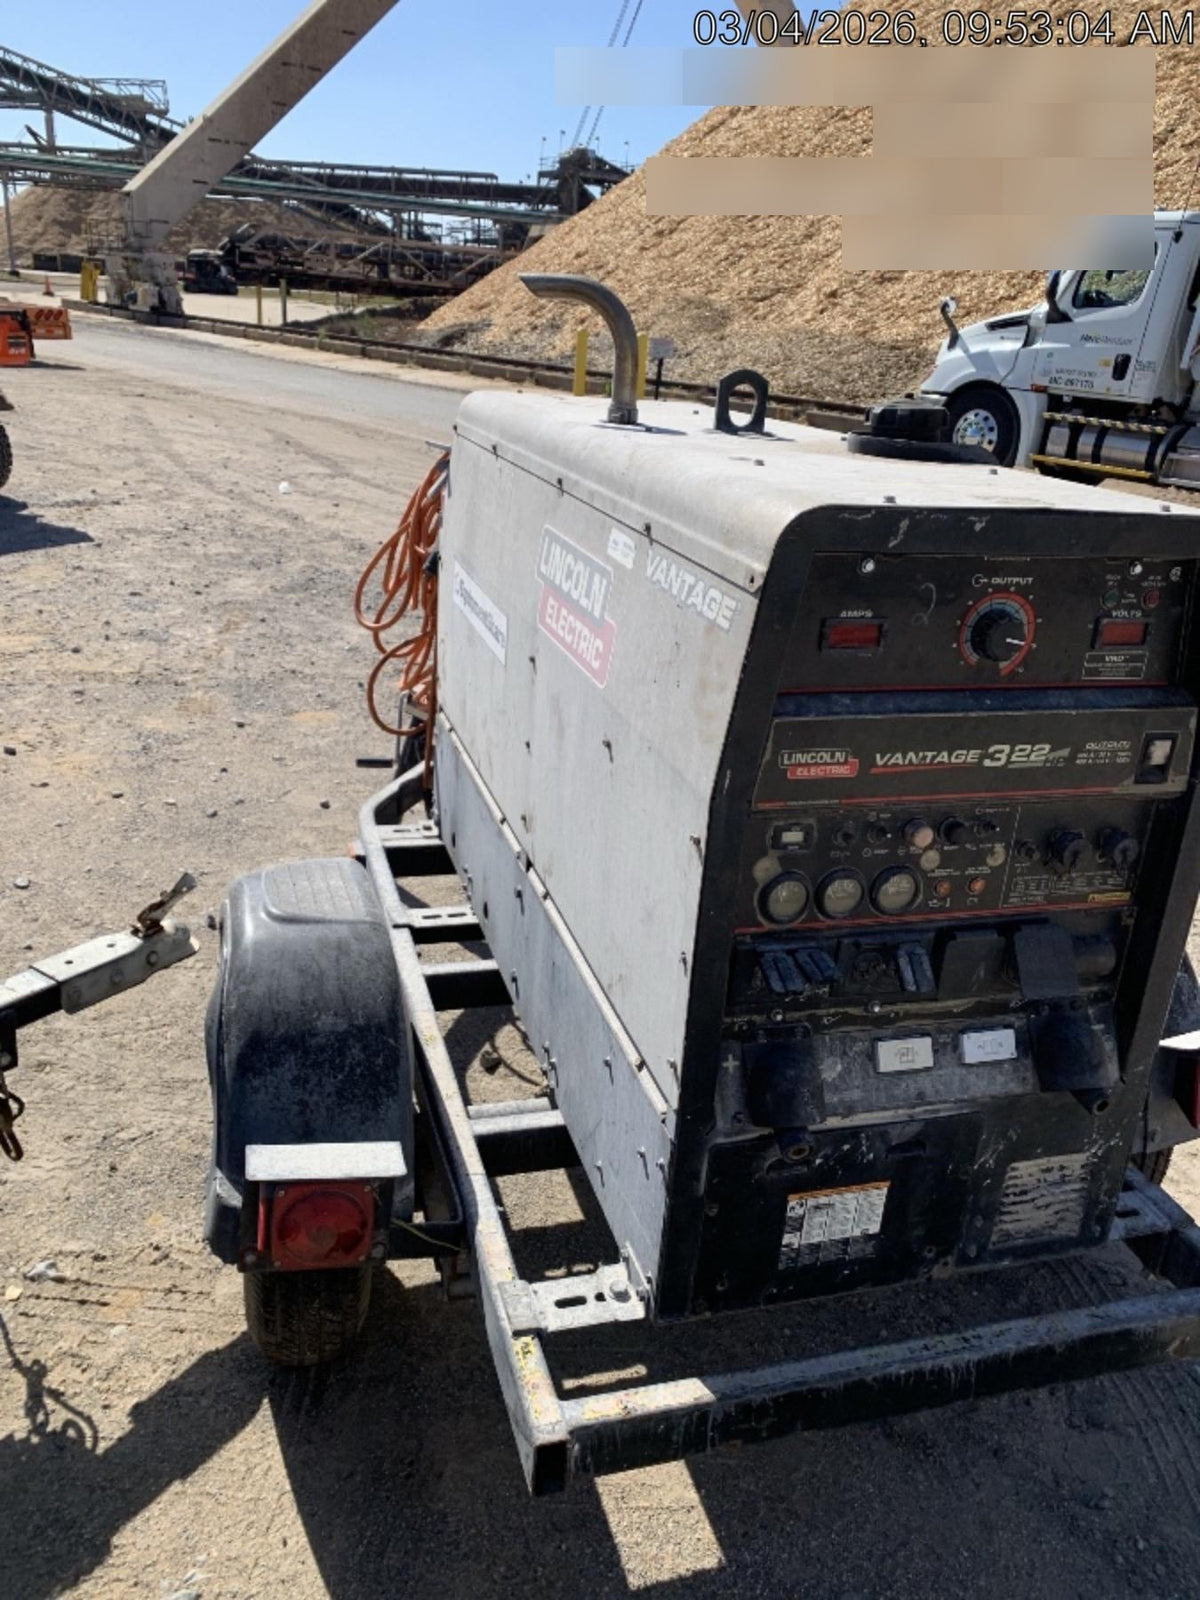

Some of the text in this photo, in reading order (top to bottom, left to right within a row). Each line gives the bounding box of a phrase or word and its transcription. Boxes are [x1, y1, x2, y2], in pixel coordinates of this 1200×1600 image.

[540, 536, 605, 620] LINCOLN
[991, 576, 1034, 586] OUTPUT
[646, 549, 737, 631] VANTAGE
[840, 609, 873, 618] AMPS
[545, 597, 603, 669] ELECTRIC
[783, 752, 846, 765] LINCOLN
[875, 750, 982, 765] VANTAGE
[983, 744, 1051, 767] 322
[796, 765, 850, 776] ELECTRIC
